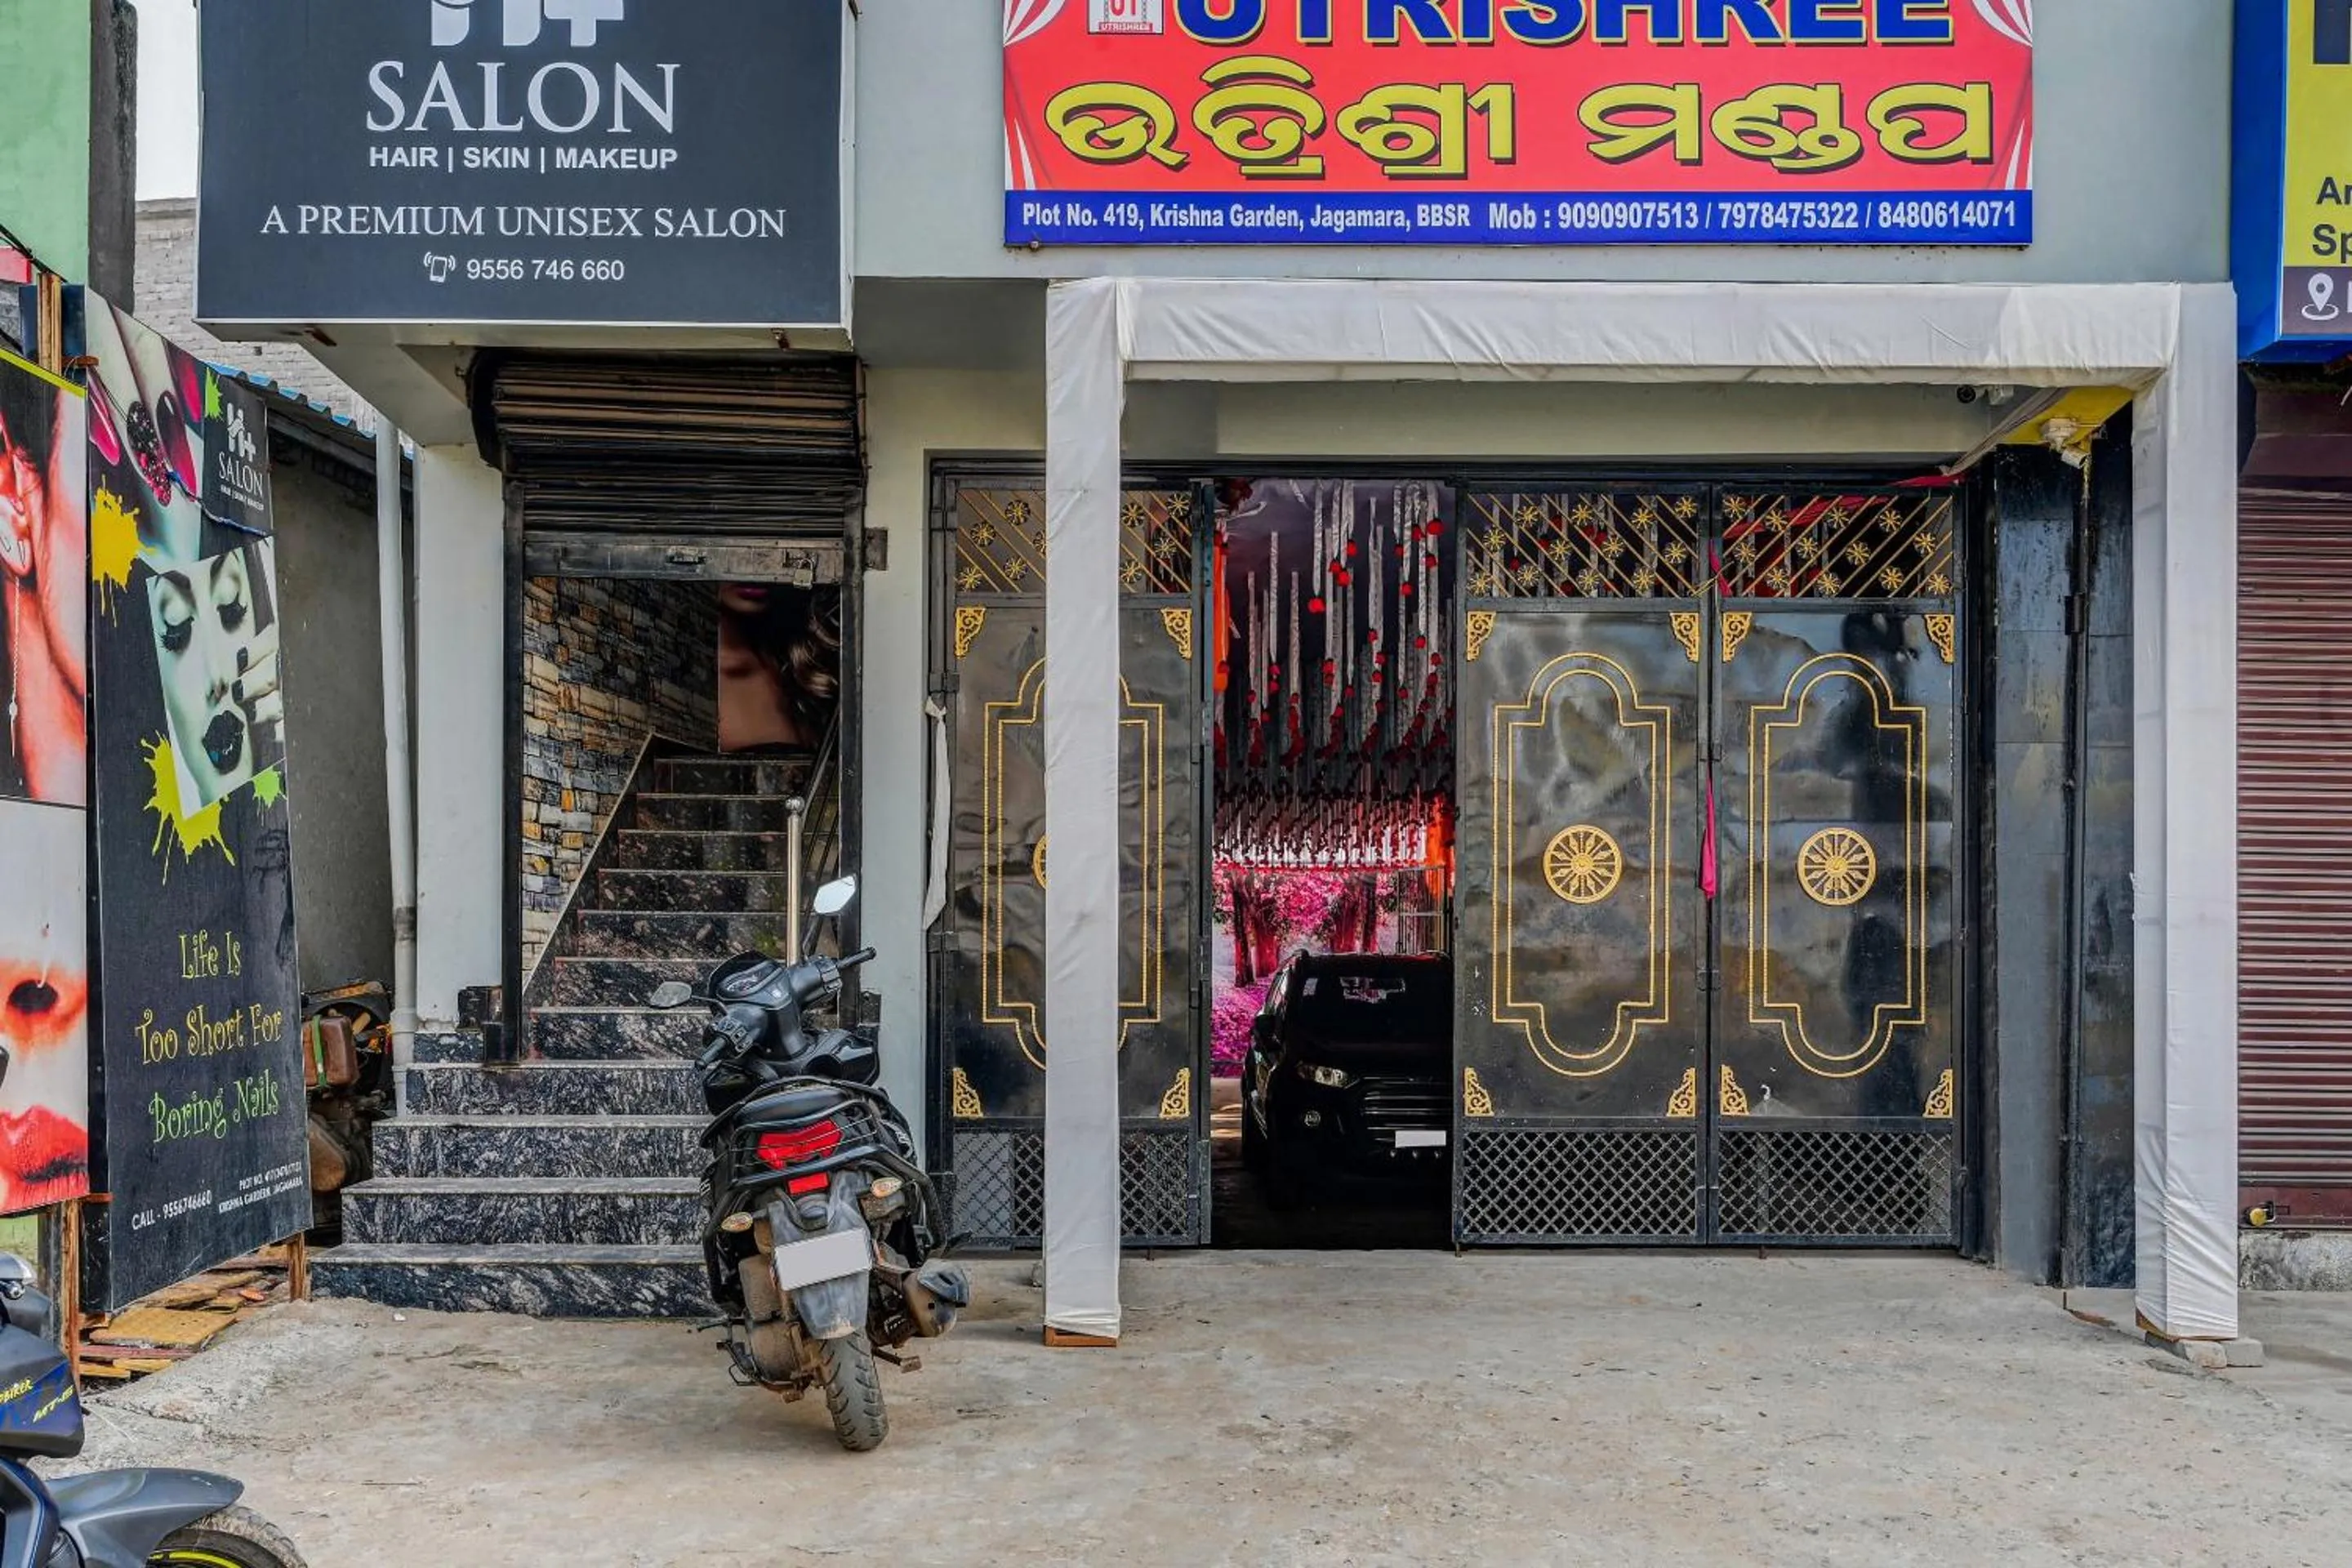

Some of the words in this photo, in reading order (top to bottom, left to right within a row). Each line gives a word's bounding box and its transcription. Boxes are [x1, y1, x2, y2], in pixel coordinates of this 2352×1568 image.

[367, 61, 680, 134] SALON
[1577, 82, 1994, 174] ମଣ୍ଡପ
[369, 147, 439, 167] HAIR
[463, 147, 530, 168] SKIN
[555, 148, 678, 170] MAKEUP
[261, 206, 289, 234] A
[297, 206, 486, 236] PREMIUM
[496, 207, 644, 237] UNISEX
[654, 208, 786, 238] SALON
[1023, 203, 1061, 226] Plot
[1067, 203, 1098, 226] No.
[1103, 203, 1144, 232] 419,
[1150, 203, 1224, 227] Krishna
[1230, 203, 1304, 233] Garden,
[1310, 204, 1410, 233] Jagamara,
[1417, 203, 1471, 227] BBSR
[1489, 203, 1537, 229] Mob
[1557, 202, 1699, 229] 9090907513
[1718, 202, 1859, 229] 7978475322
[1878, 200, 2016, 228] 8480614071
[466, 259, 524, 281] 9556
[532, 260, 575, 281] 746
[581, 260, 625, 281] 660
[219, 451, 264, 497] SALON
[179, 929, 219, 979] Life
[225, 931, 242, 977] Is
[134, 1008, 178, 1065] Too
[185, 1004, 244, 1056] Short
[249, 1003, 283, 1046] For
[148, 1087, 227, 1143] Boring
[232, 1069, 279, 1124] Nails
[131, 1209, 156, 1231] CALL
